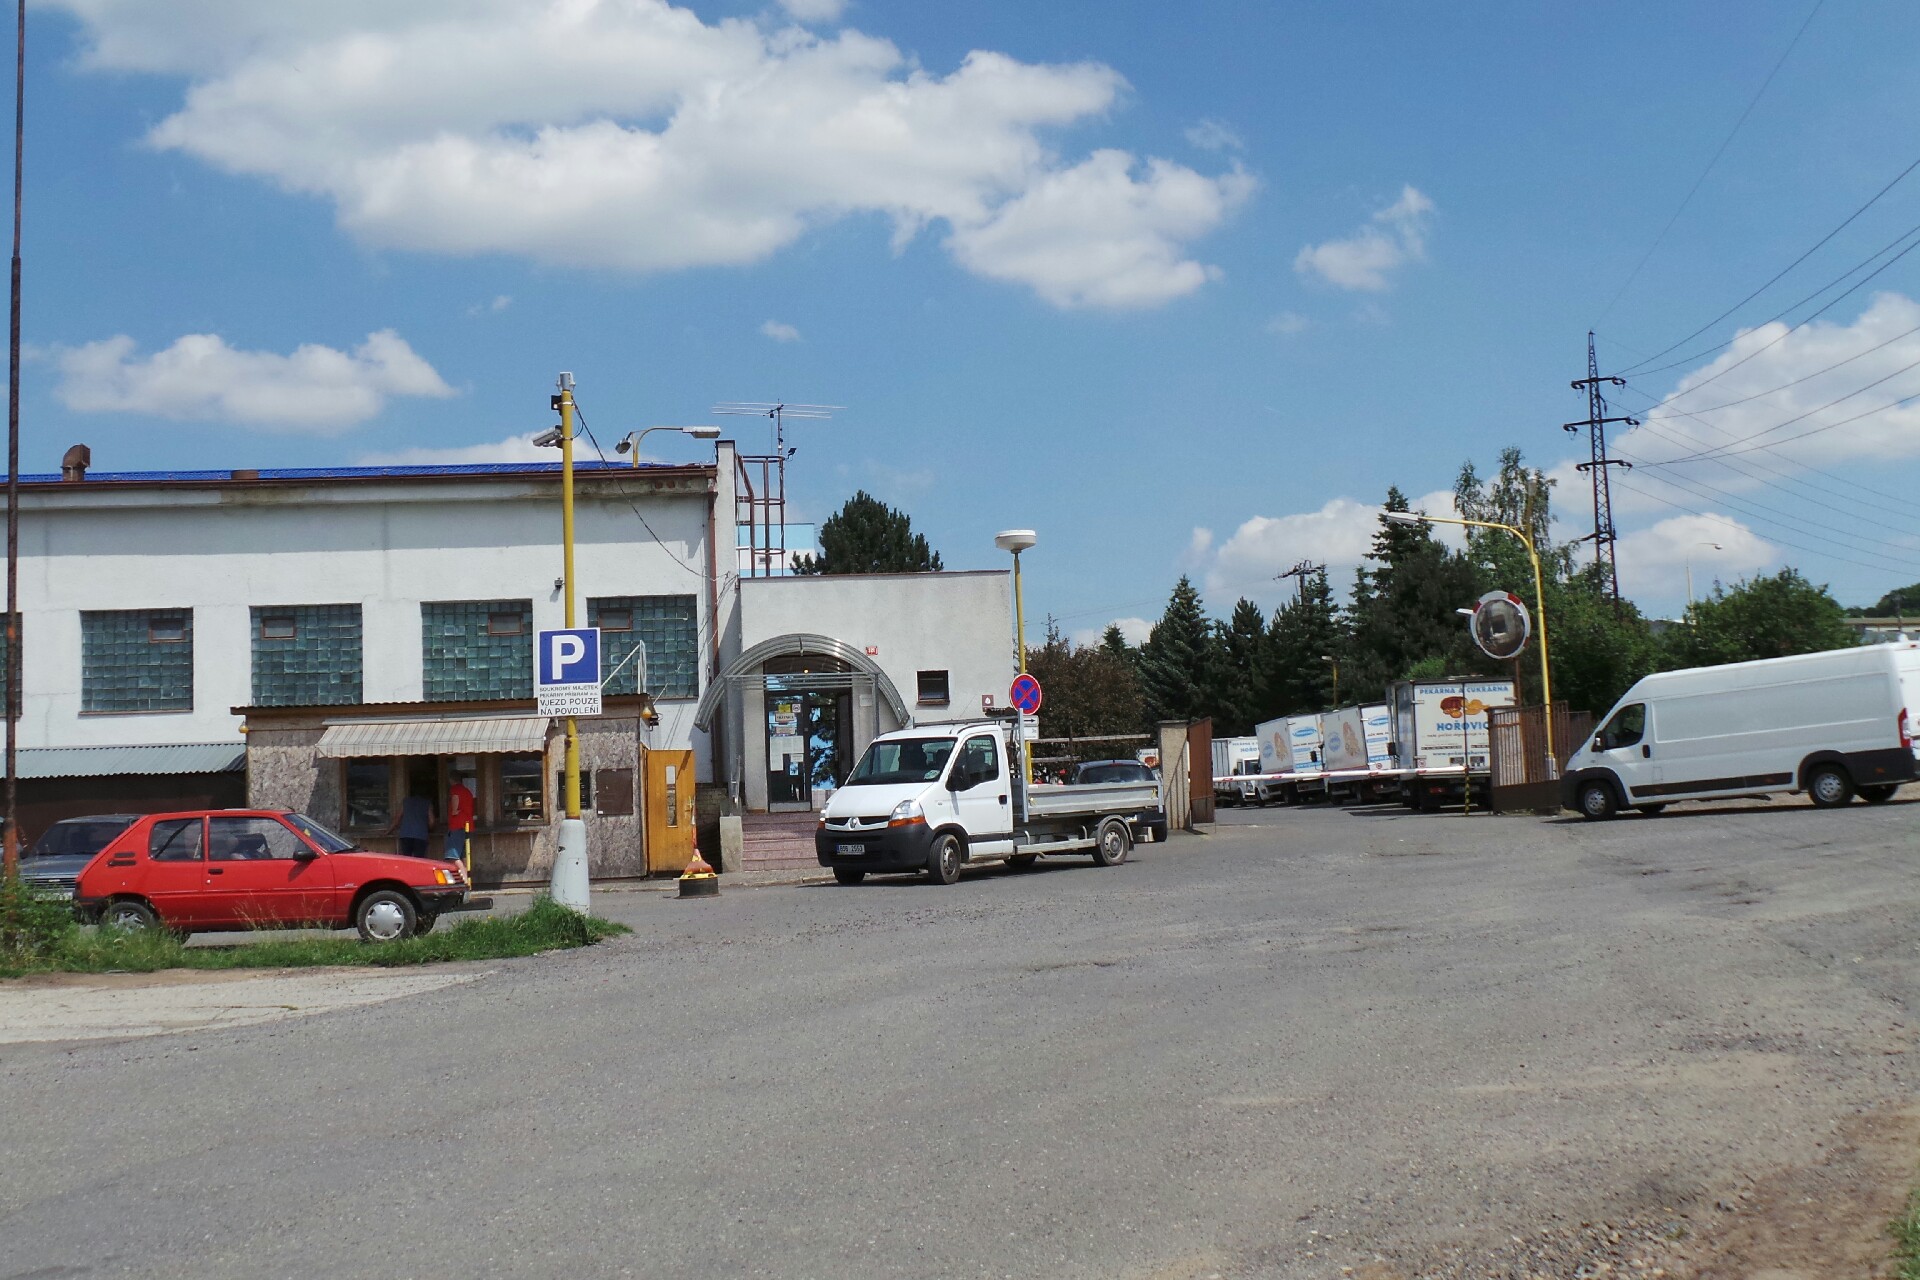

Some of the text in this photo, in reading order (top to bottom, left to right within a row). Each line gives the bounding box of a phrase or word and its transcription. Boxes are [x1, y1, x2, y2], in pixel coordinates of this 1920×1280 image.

[552, 634, 585, 680] P
[540, 697, 599, 706] VJEZD POUZE
